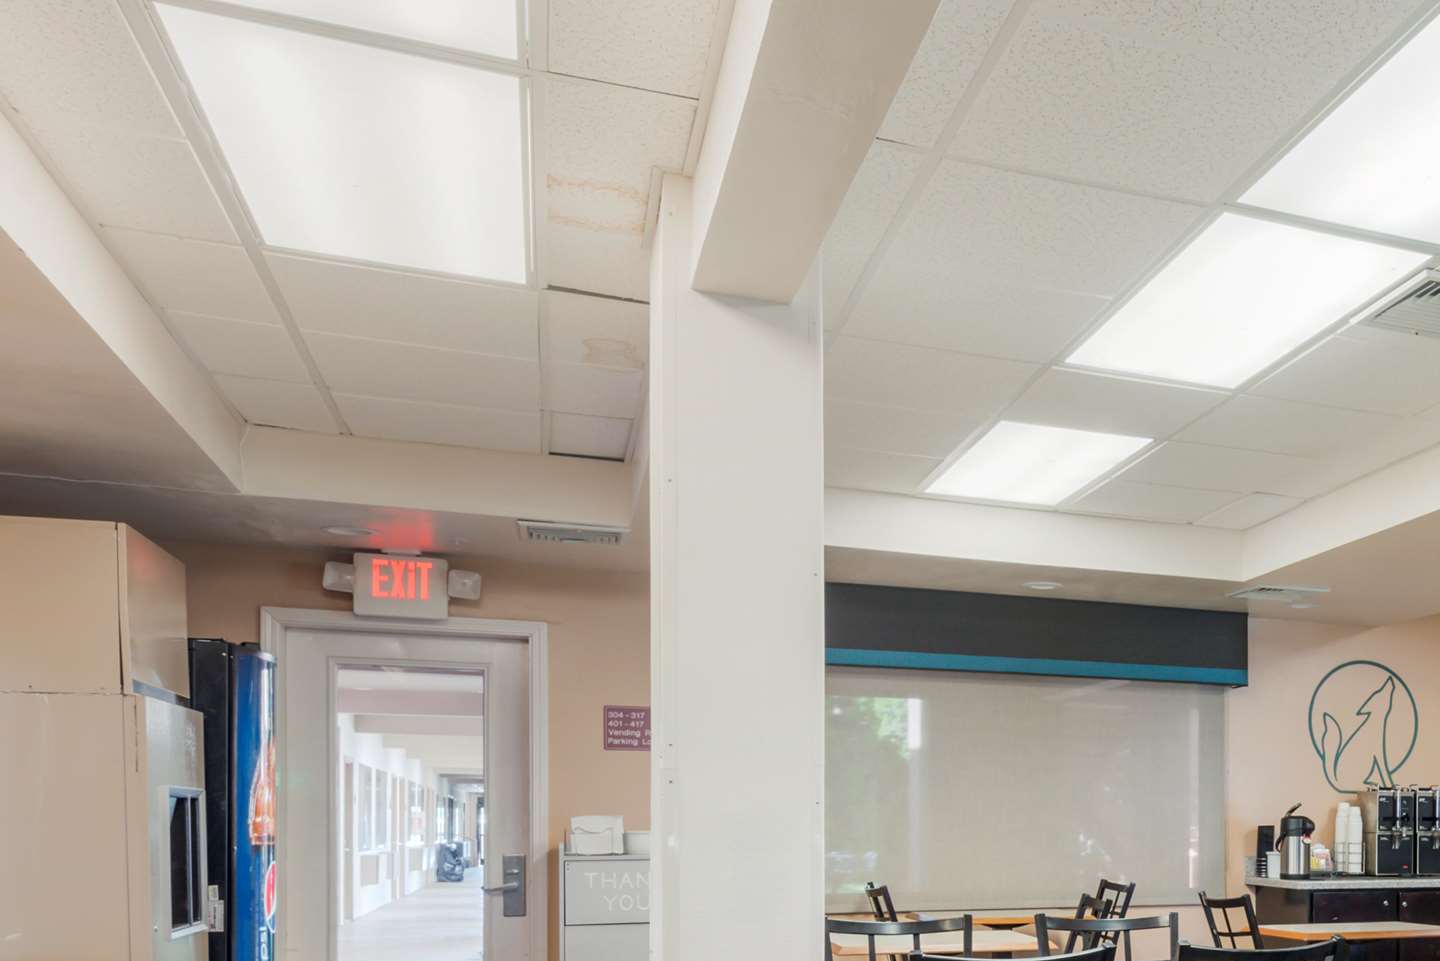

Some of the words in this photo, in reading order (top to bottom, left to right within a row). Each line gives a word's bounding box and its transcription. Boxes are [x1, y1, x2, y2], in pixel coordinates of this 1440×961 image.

[371, 558, 433, 600] EXIT
[607, 729, 641, 738] Vending
[607, 737, 639, 746] Parking
[583, 871, 649, 889] THAN
[603, 894, 649, 912] YOU
